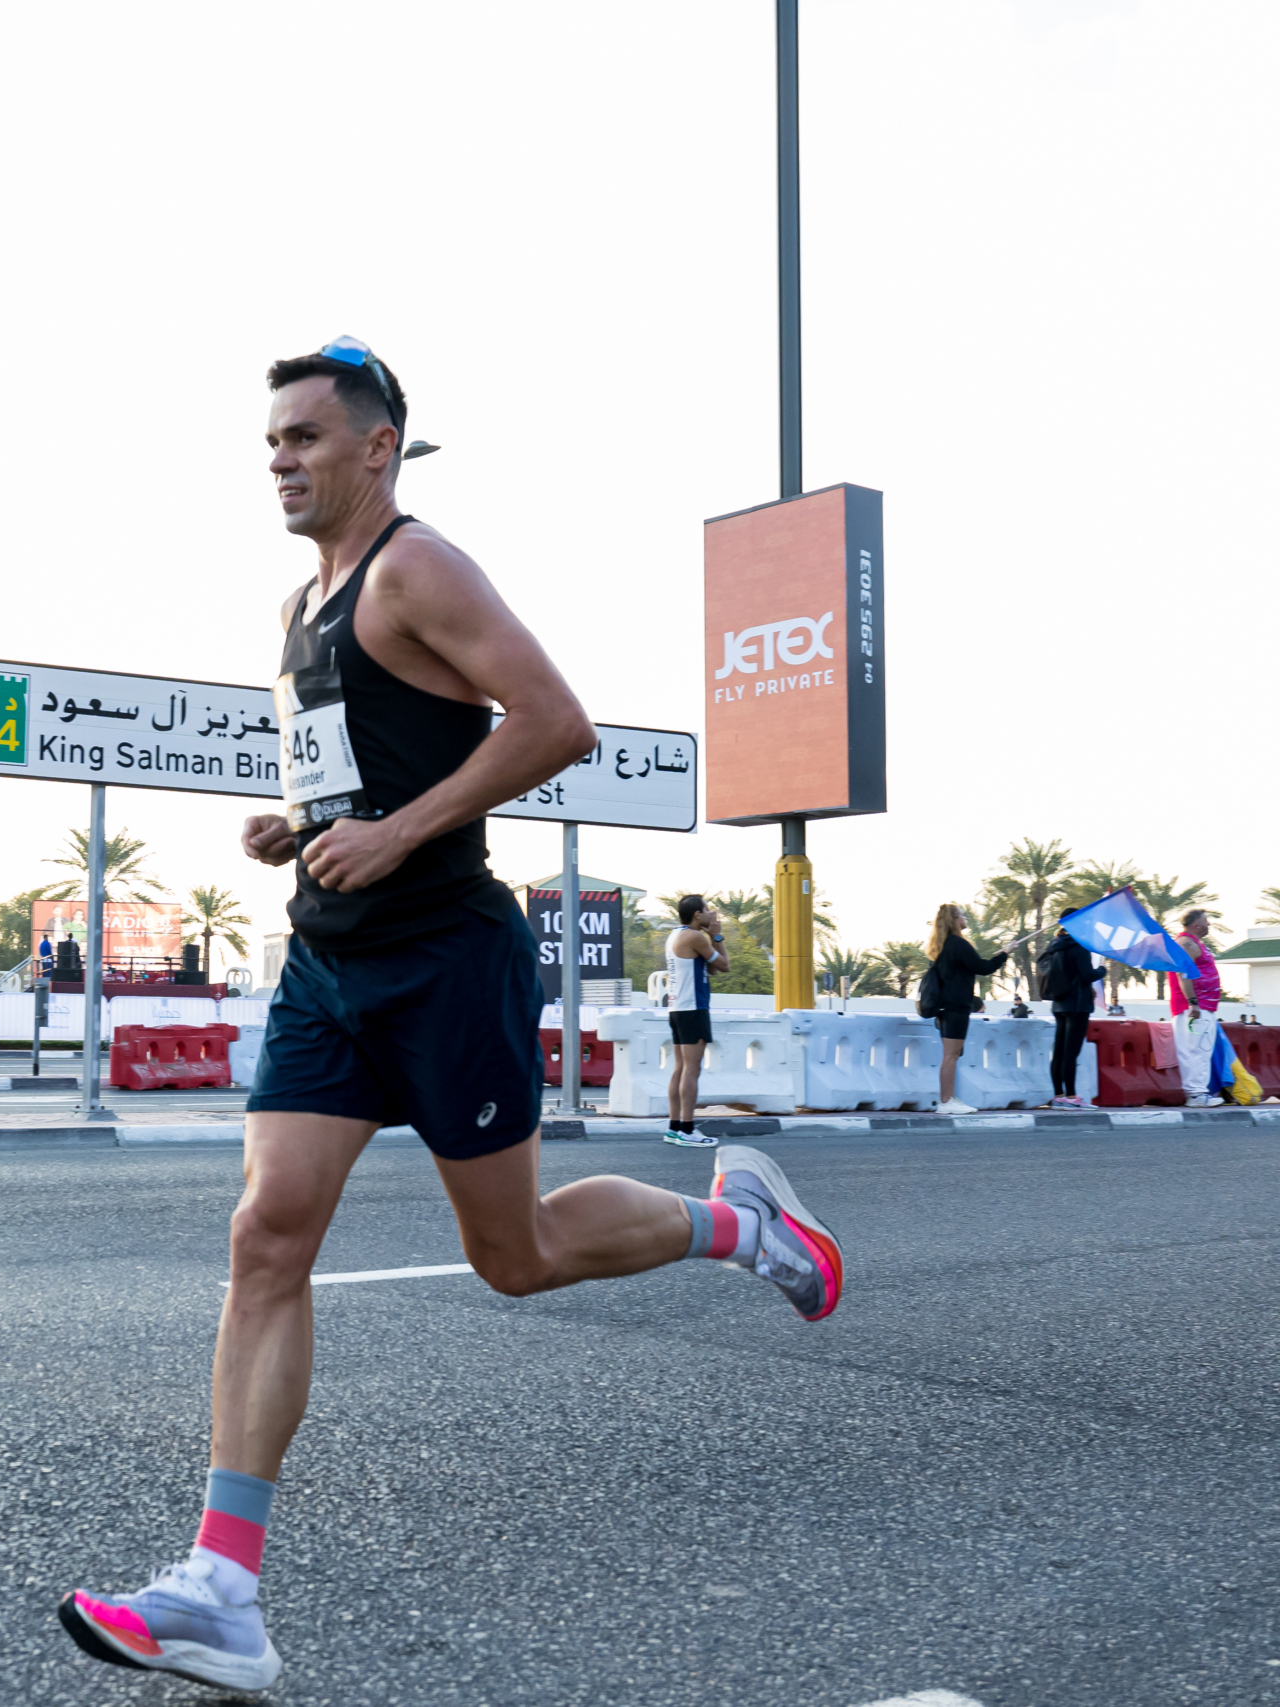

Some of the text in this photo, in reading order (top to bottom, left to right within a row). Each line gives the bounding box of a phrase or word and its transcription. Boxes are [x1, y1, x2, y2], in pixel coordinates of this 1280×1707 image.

[859, 549, 874, 684] 04 295 3031
[715, 611, 834, 680] JETEX
[715, 669, 834, 704] FLY PRIVATE
[4, 697, 18, 711] د
[41, 691, 139, 723] سعود
[151, 689, 188, 732] آل
[39, 734, 565, 806] King Salman Bin St
[615, 744, 689, 780] شارع
[323, 800, 353, 816] DUBAI
[782, 863, 789, 873] 1
[102, 915, 155, 930] RADIO
[539, 941, 613, 967] STRT
